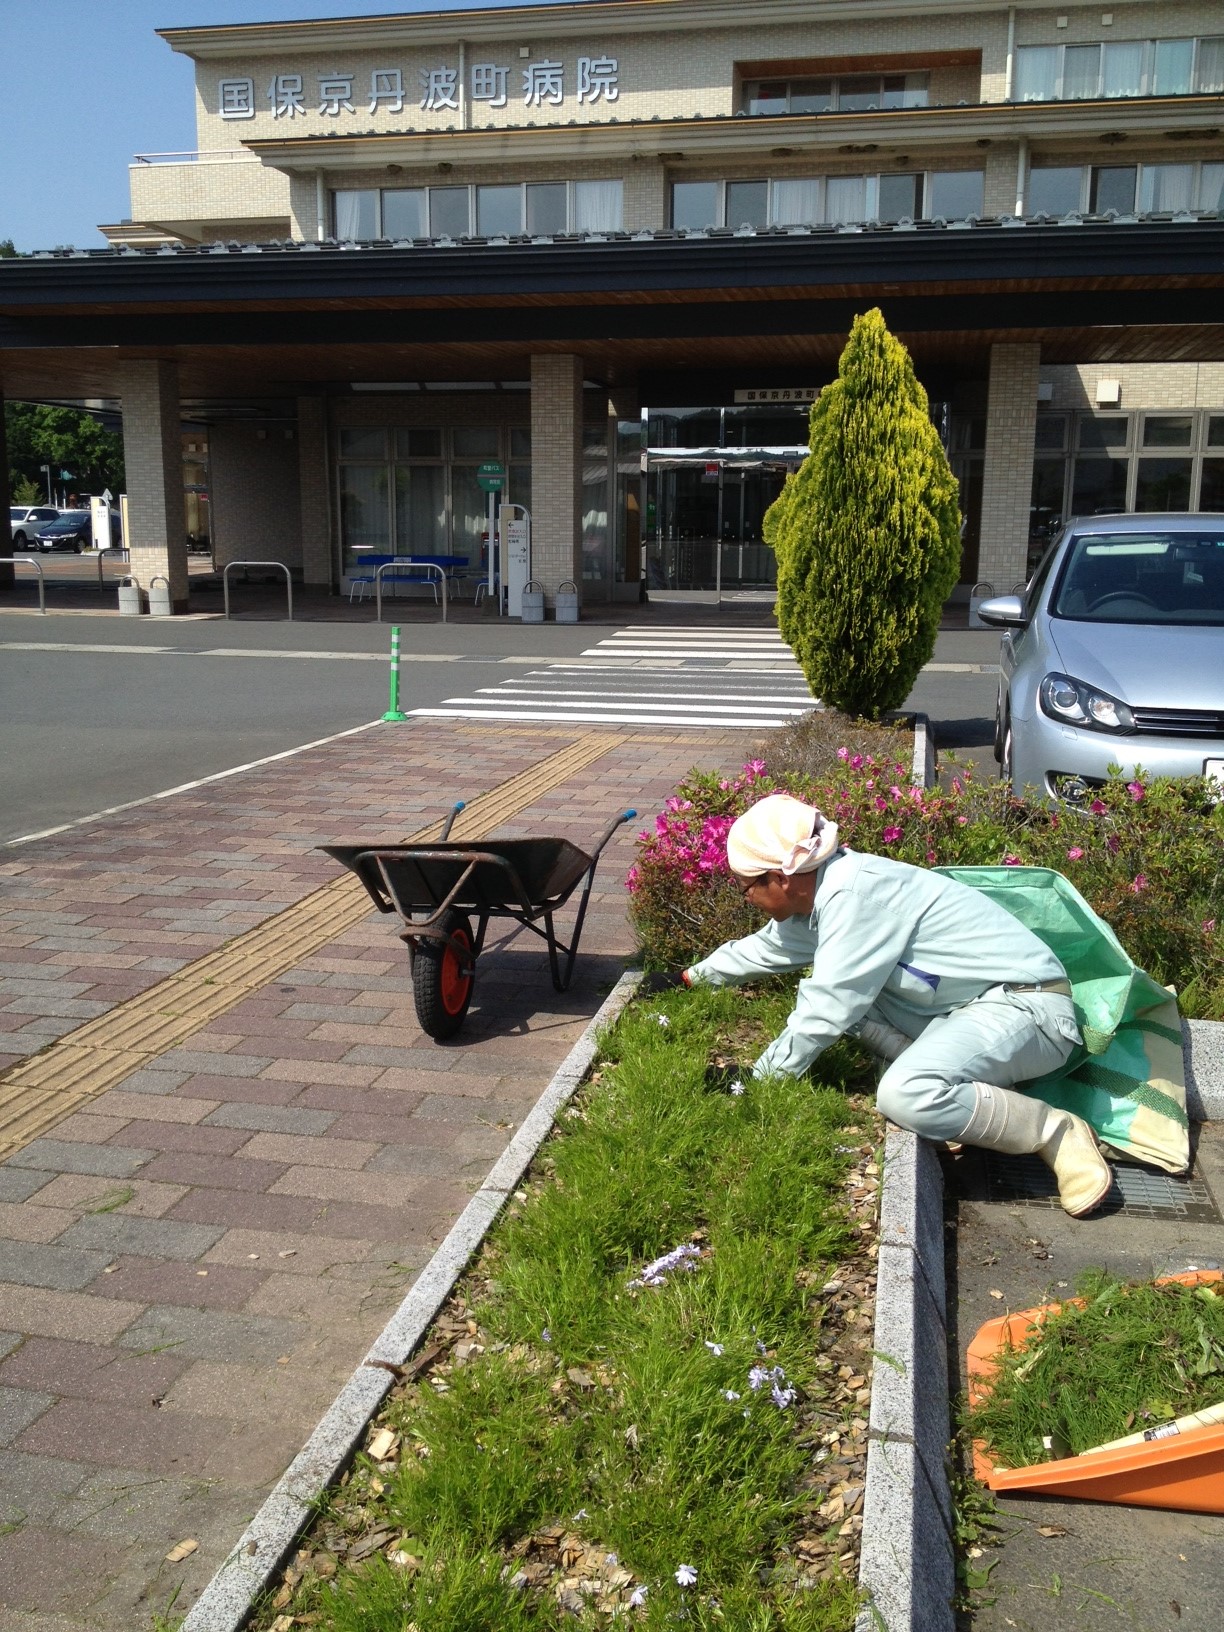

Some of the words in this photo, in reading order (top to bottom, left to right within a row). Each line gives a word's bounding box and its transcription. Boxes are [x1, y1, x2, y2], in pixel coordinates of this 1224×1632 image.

[217, 55, 620, 120] 国保京丹波町病院
